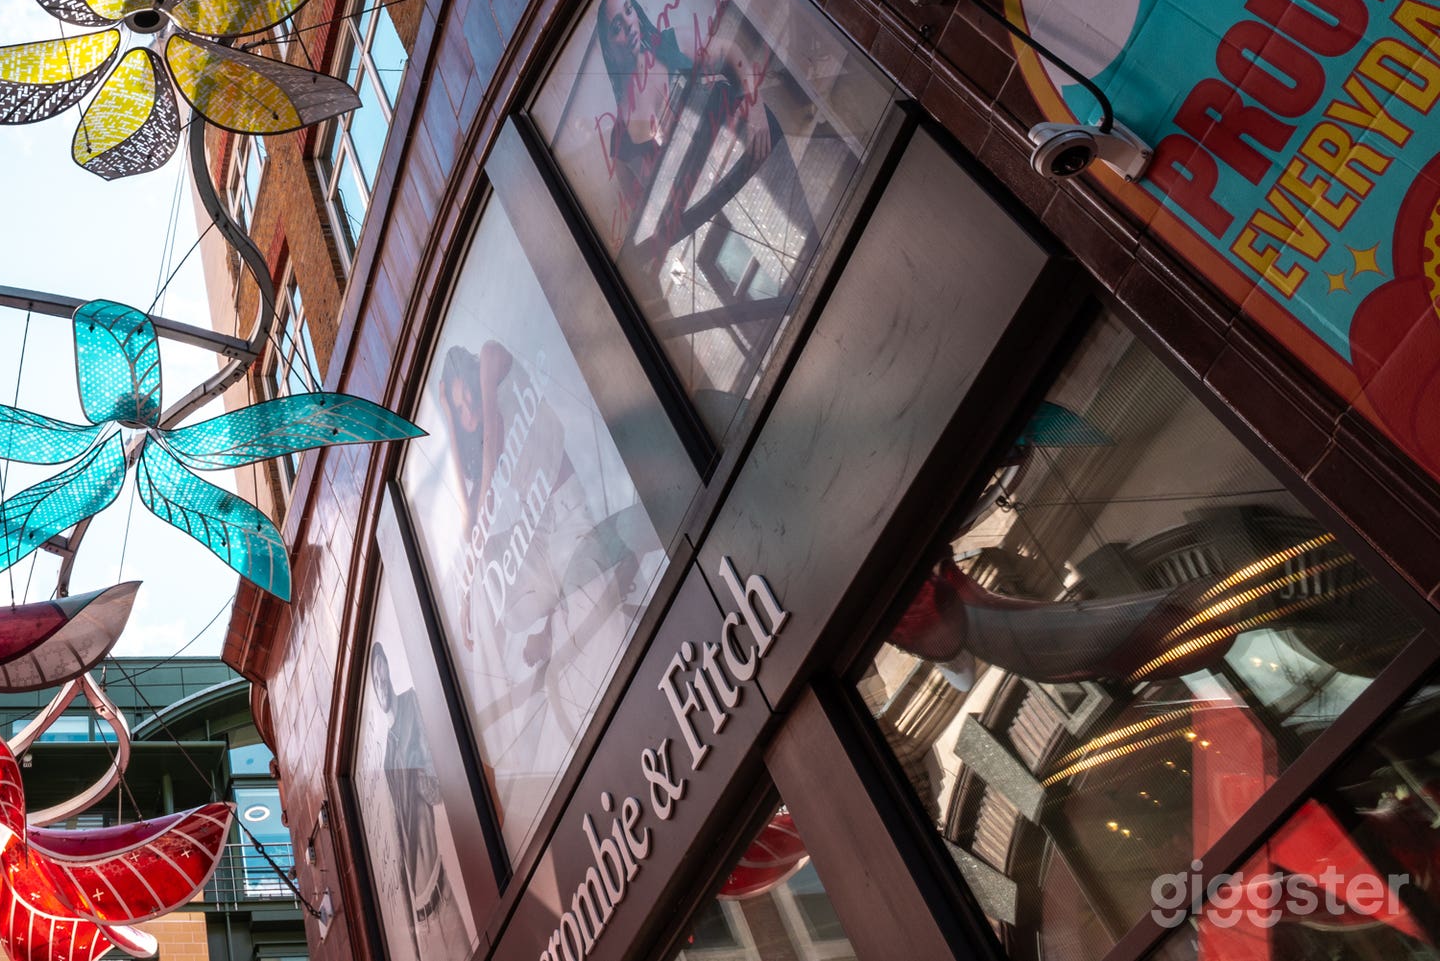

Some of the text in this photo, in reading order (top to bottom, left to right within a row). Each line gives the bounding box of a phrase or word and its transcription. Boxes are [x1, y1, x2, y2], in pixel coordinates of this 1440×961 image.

[482, 467, 554, 626] Denim
[540, 555, 790, 961] ombie & Fitch
